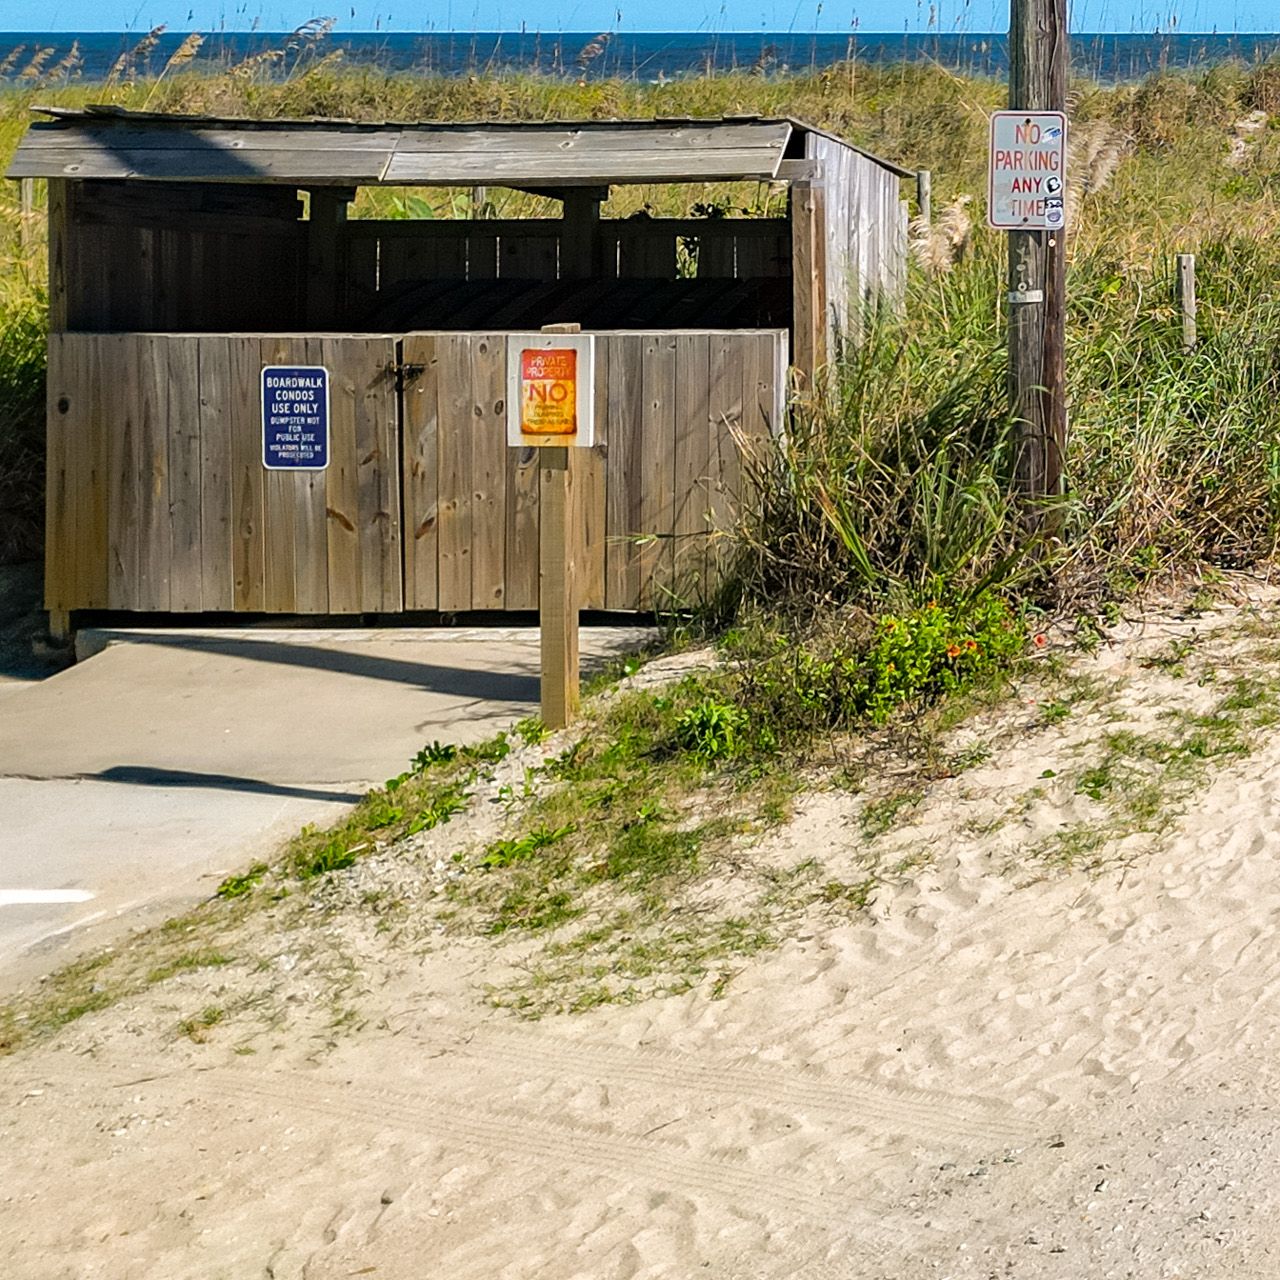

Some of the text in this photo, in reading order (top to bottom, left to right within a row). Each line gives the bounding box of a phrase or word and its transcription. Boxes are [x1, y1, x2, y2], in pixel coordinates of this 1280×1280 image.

[1015, 124, 1041, 145] NO
[995, 150, 1059, 171] PARKING
[1011, 177, 1043, 194] ANY
[1011, 200, 1045, 216] TIME
[531, 355, 567, 366] PRIVATE
[527, 366, 570, 377] PROPERTY
[266, 377, 323, 388] BOARDWALK
[275, 390, 314, 401] CONDOS
[528, 382, 568, 402] NO
[271, 403, 318, 414] USE ONLY
